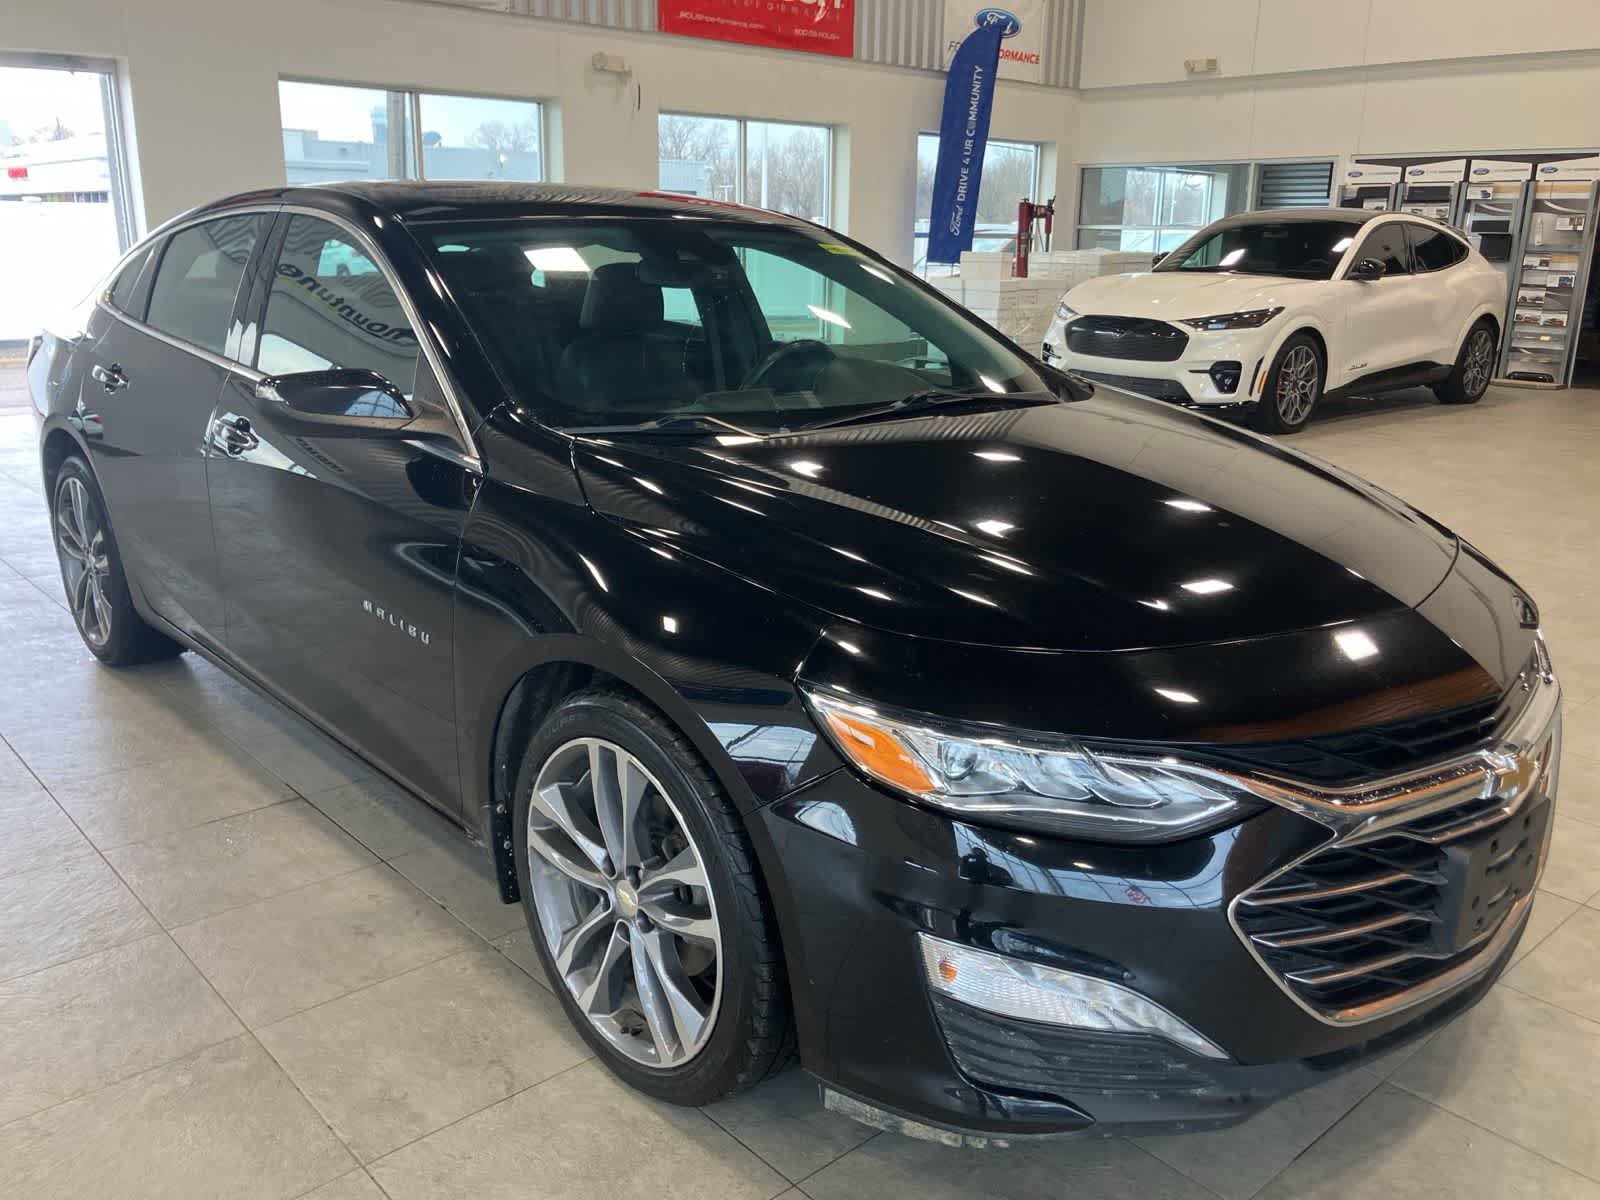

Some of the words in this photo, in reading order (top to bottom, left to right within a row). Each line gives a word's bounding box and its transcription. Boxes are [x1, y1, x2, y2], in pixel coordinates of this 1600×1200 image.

[965, 65, 984, 137] COMMUNITY
[963, 138, 975, 156] UR
[956, 167, 969, 201] DRIVE
[362, 599, 430, 645] MALIBU
